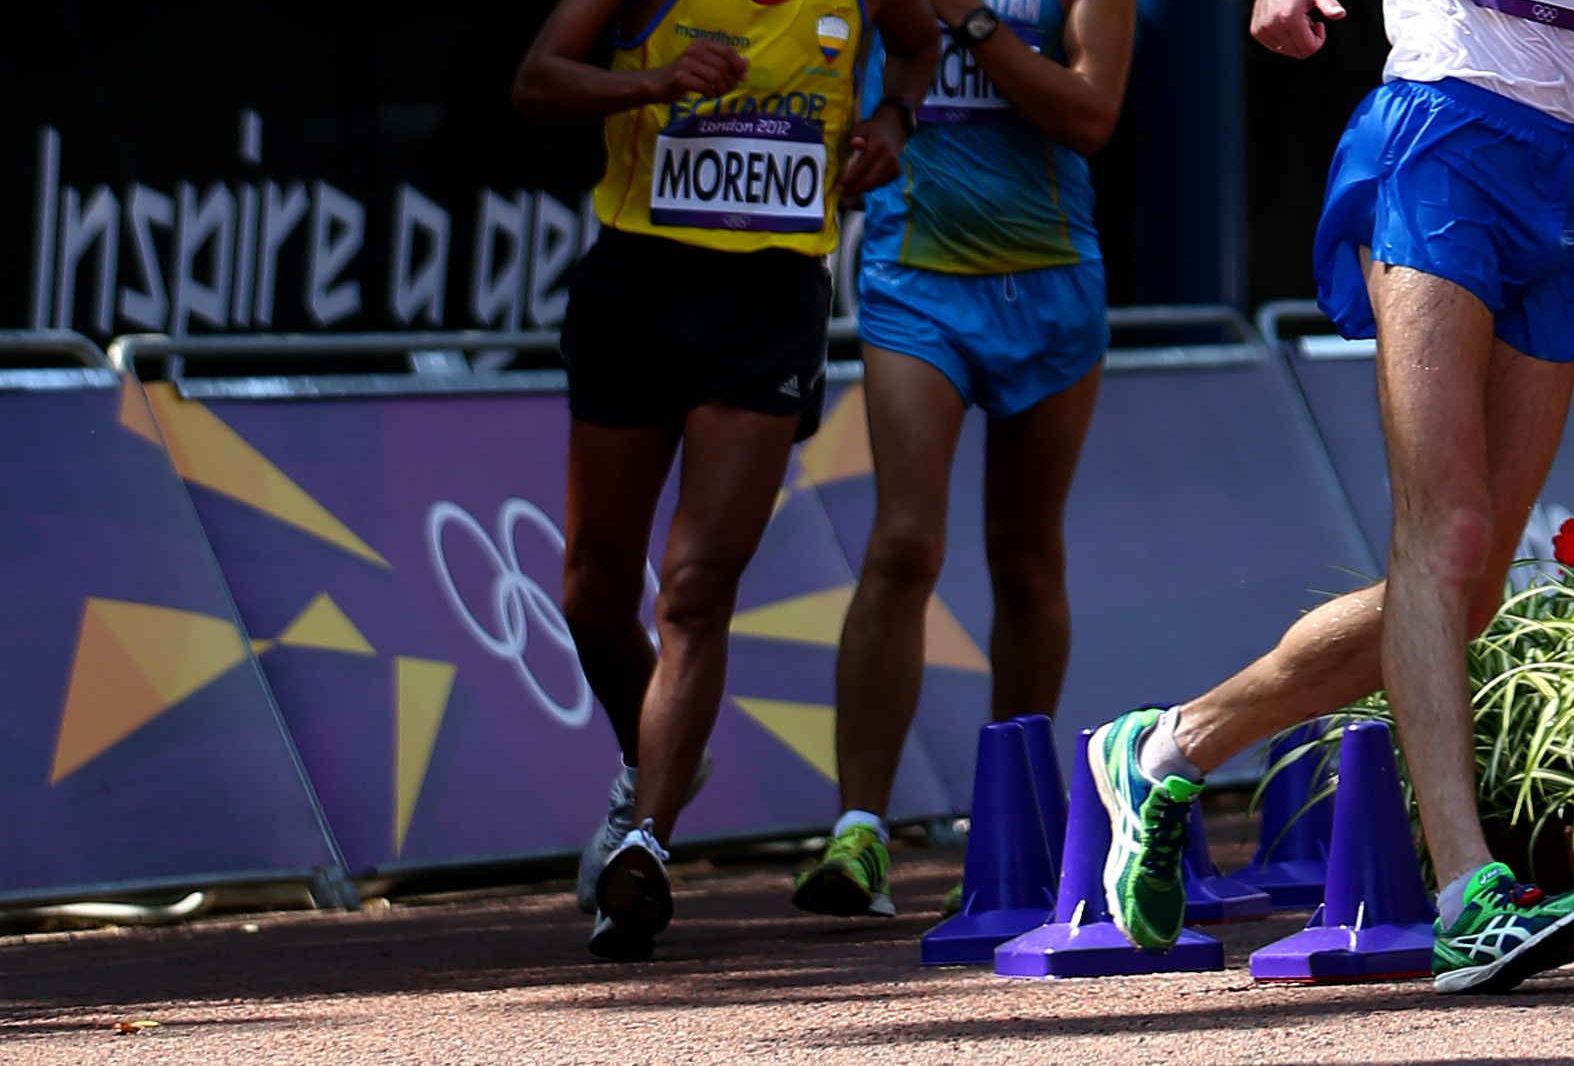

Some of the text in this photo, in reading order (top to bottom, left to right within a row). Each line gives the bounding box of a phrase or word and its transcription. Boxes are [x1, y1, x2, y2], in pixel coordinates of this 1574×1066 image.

[700, 118, 793, 136] London 2012
[658, 148, 819, 208] MORENO
[30, 108, 368, 382] Inspire
[389, 180, 453, 327] a
